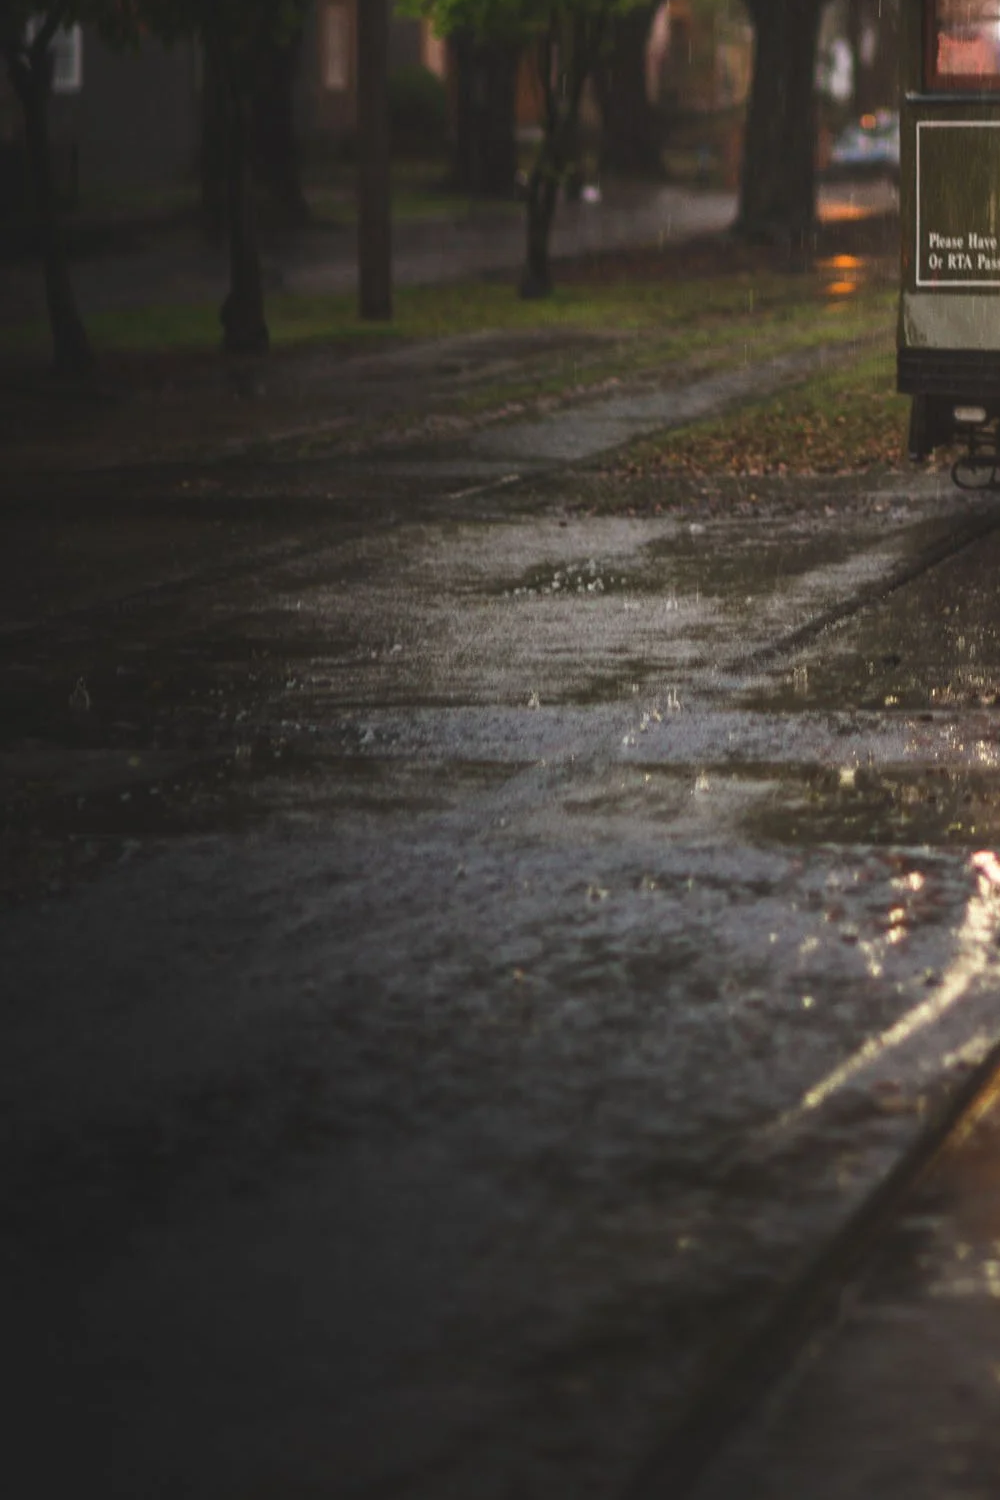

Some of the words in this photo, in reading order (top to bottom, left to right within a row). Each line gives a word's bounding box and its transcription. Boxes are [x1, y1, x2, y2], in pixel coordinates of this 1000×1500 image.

[928, 232, 963, 250] Please
[968, 232, 997, 250] Have
[928, 254, 943, 270] Or
[948, 254, 973, 270] RTA
